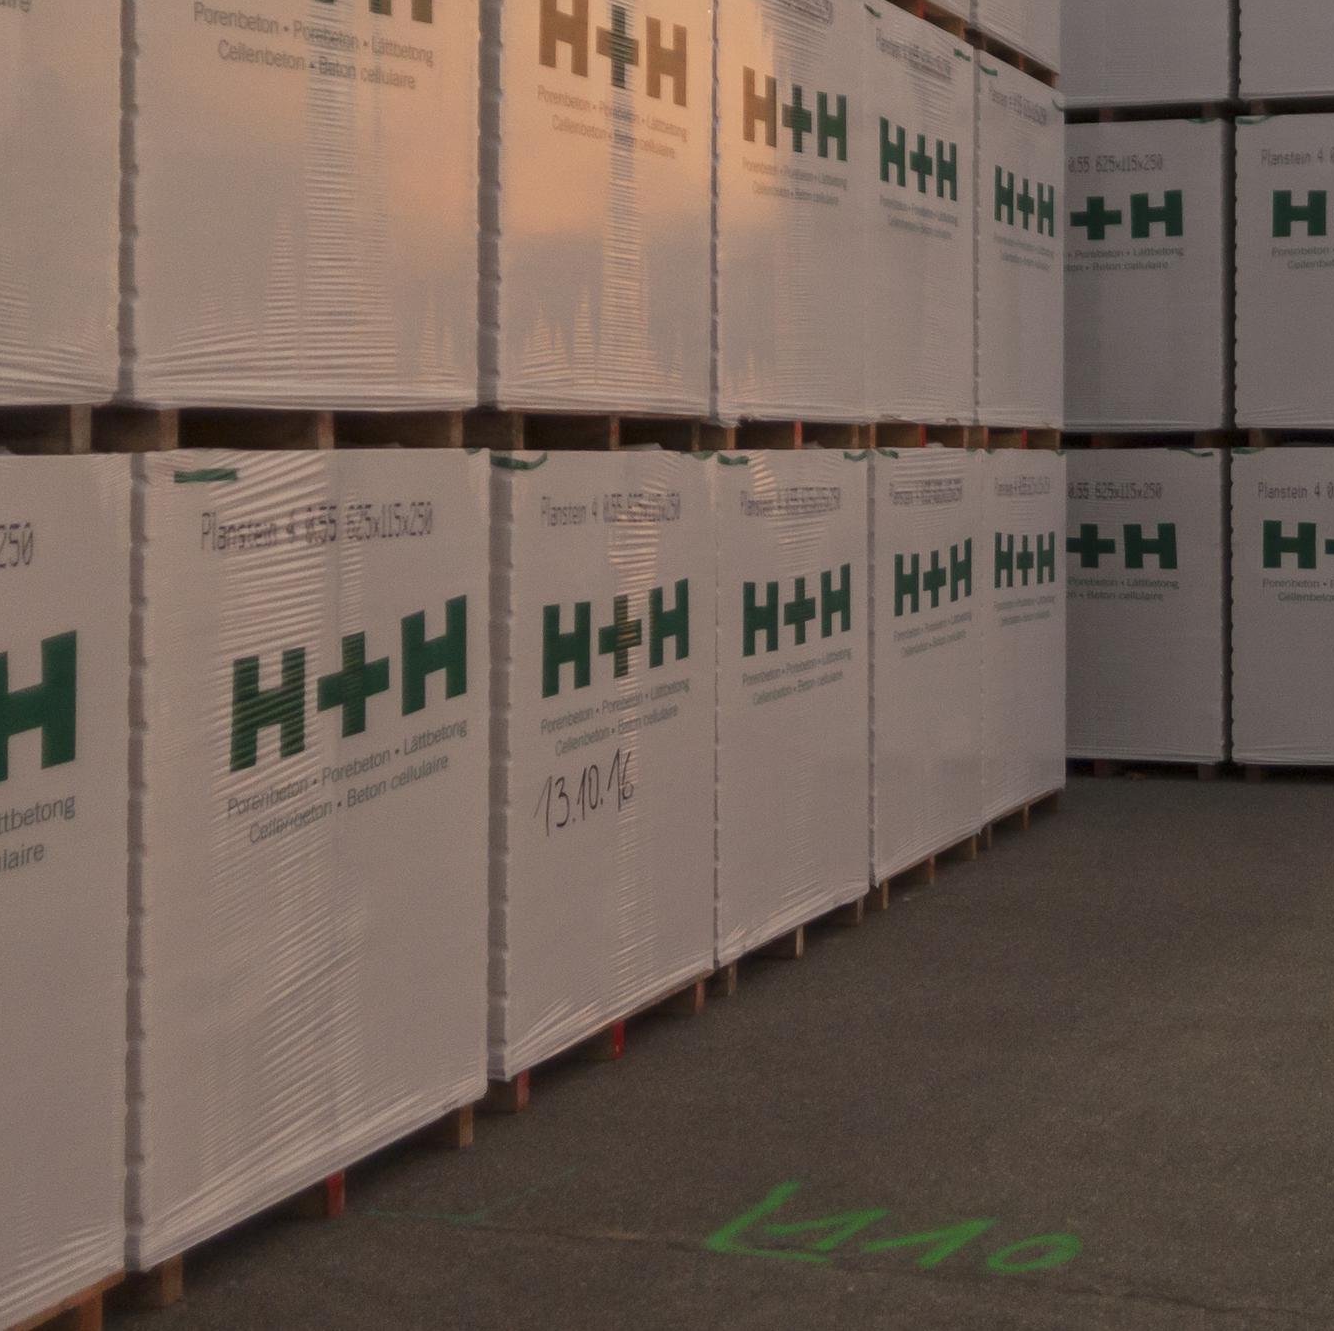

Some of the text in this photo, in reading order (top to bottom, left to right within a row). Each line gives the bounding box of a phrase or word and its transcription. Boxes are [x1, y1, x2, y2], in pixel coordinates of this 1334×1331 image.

[194, 1, 279, 35] Porenbeton
[742, 66, 847, 161] H+H
[880, 116, 957, 201] H+H
[995, 165, 1054, 237] H+H
[1070, 189, 1183, 240] +H
[894, 537, 972, 617] H+H
[994, 531, 1055, 589] H+H
[1066, 523, 1177, 569] +H
[542, 578, 689, 700] H+H
[742, 563, 851, 657] H+H
[230, 594, 467, 773] H+H
[227, 777, 309, 817] Porenbeton
[322, 747, 391, 784] Porebeton
[249, 755, 449, 843] Cellenbeton Beton cellulaire
